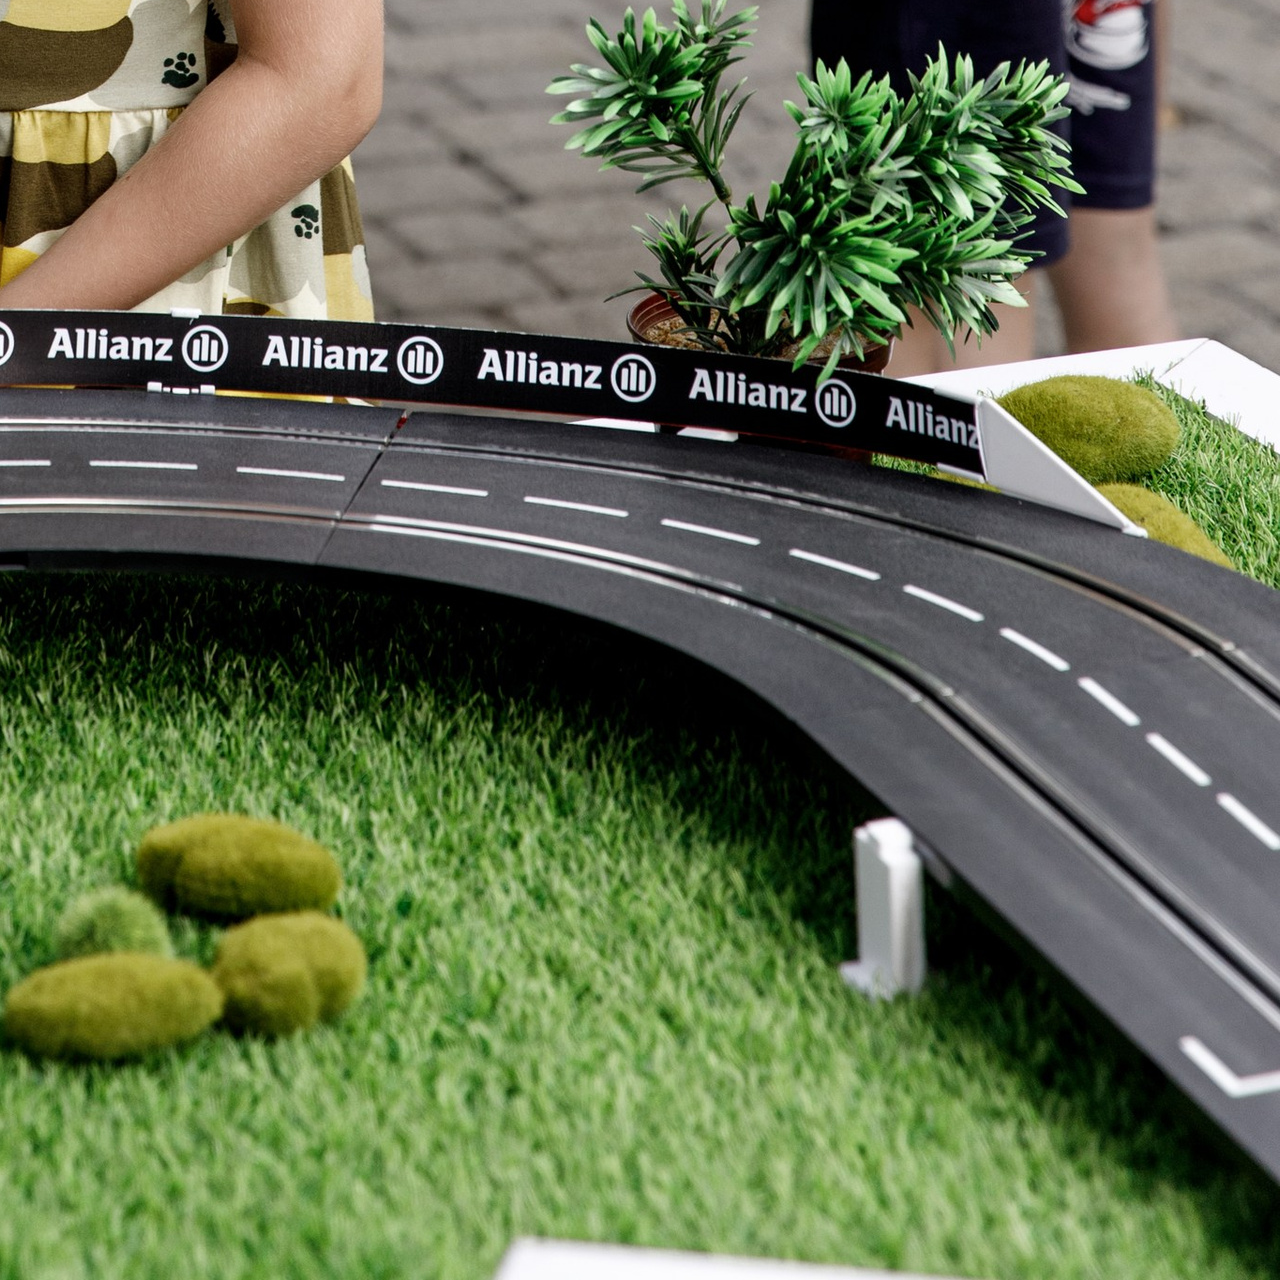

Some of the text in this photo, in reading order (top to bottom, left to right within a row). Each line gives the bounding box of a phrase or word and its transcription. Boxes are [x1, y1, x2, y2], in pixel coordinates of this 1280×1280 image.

[47, 327, 173, 362] Allianz
[261, 334, 388, 373] Allianz
[477, 348, 602, 391] Allianz
[688, 367, 808, 414] Allianz
[885, 396, 979, 450] Allianz
